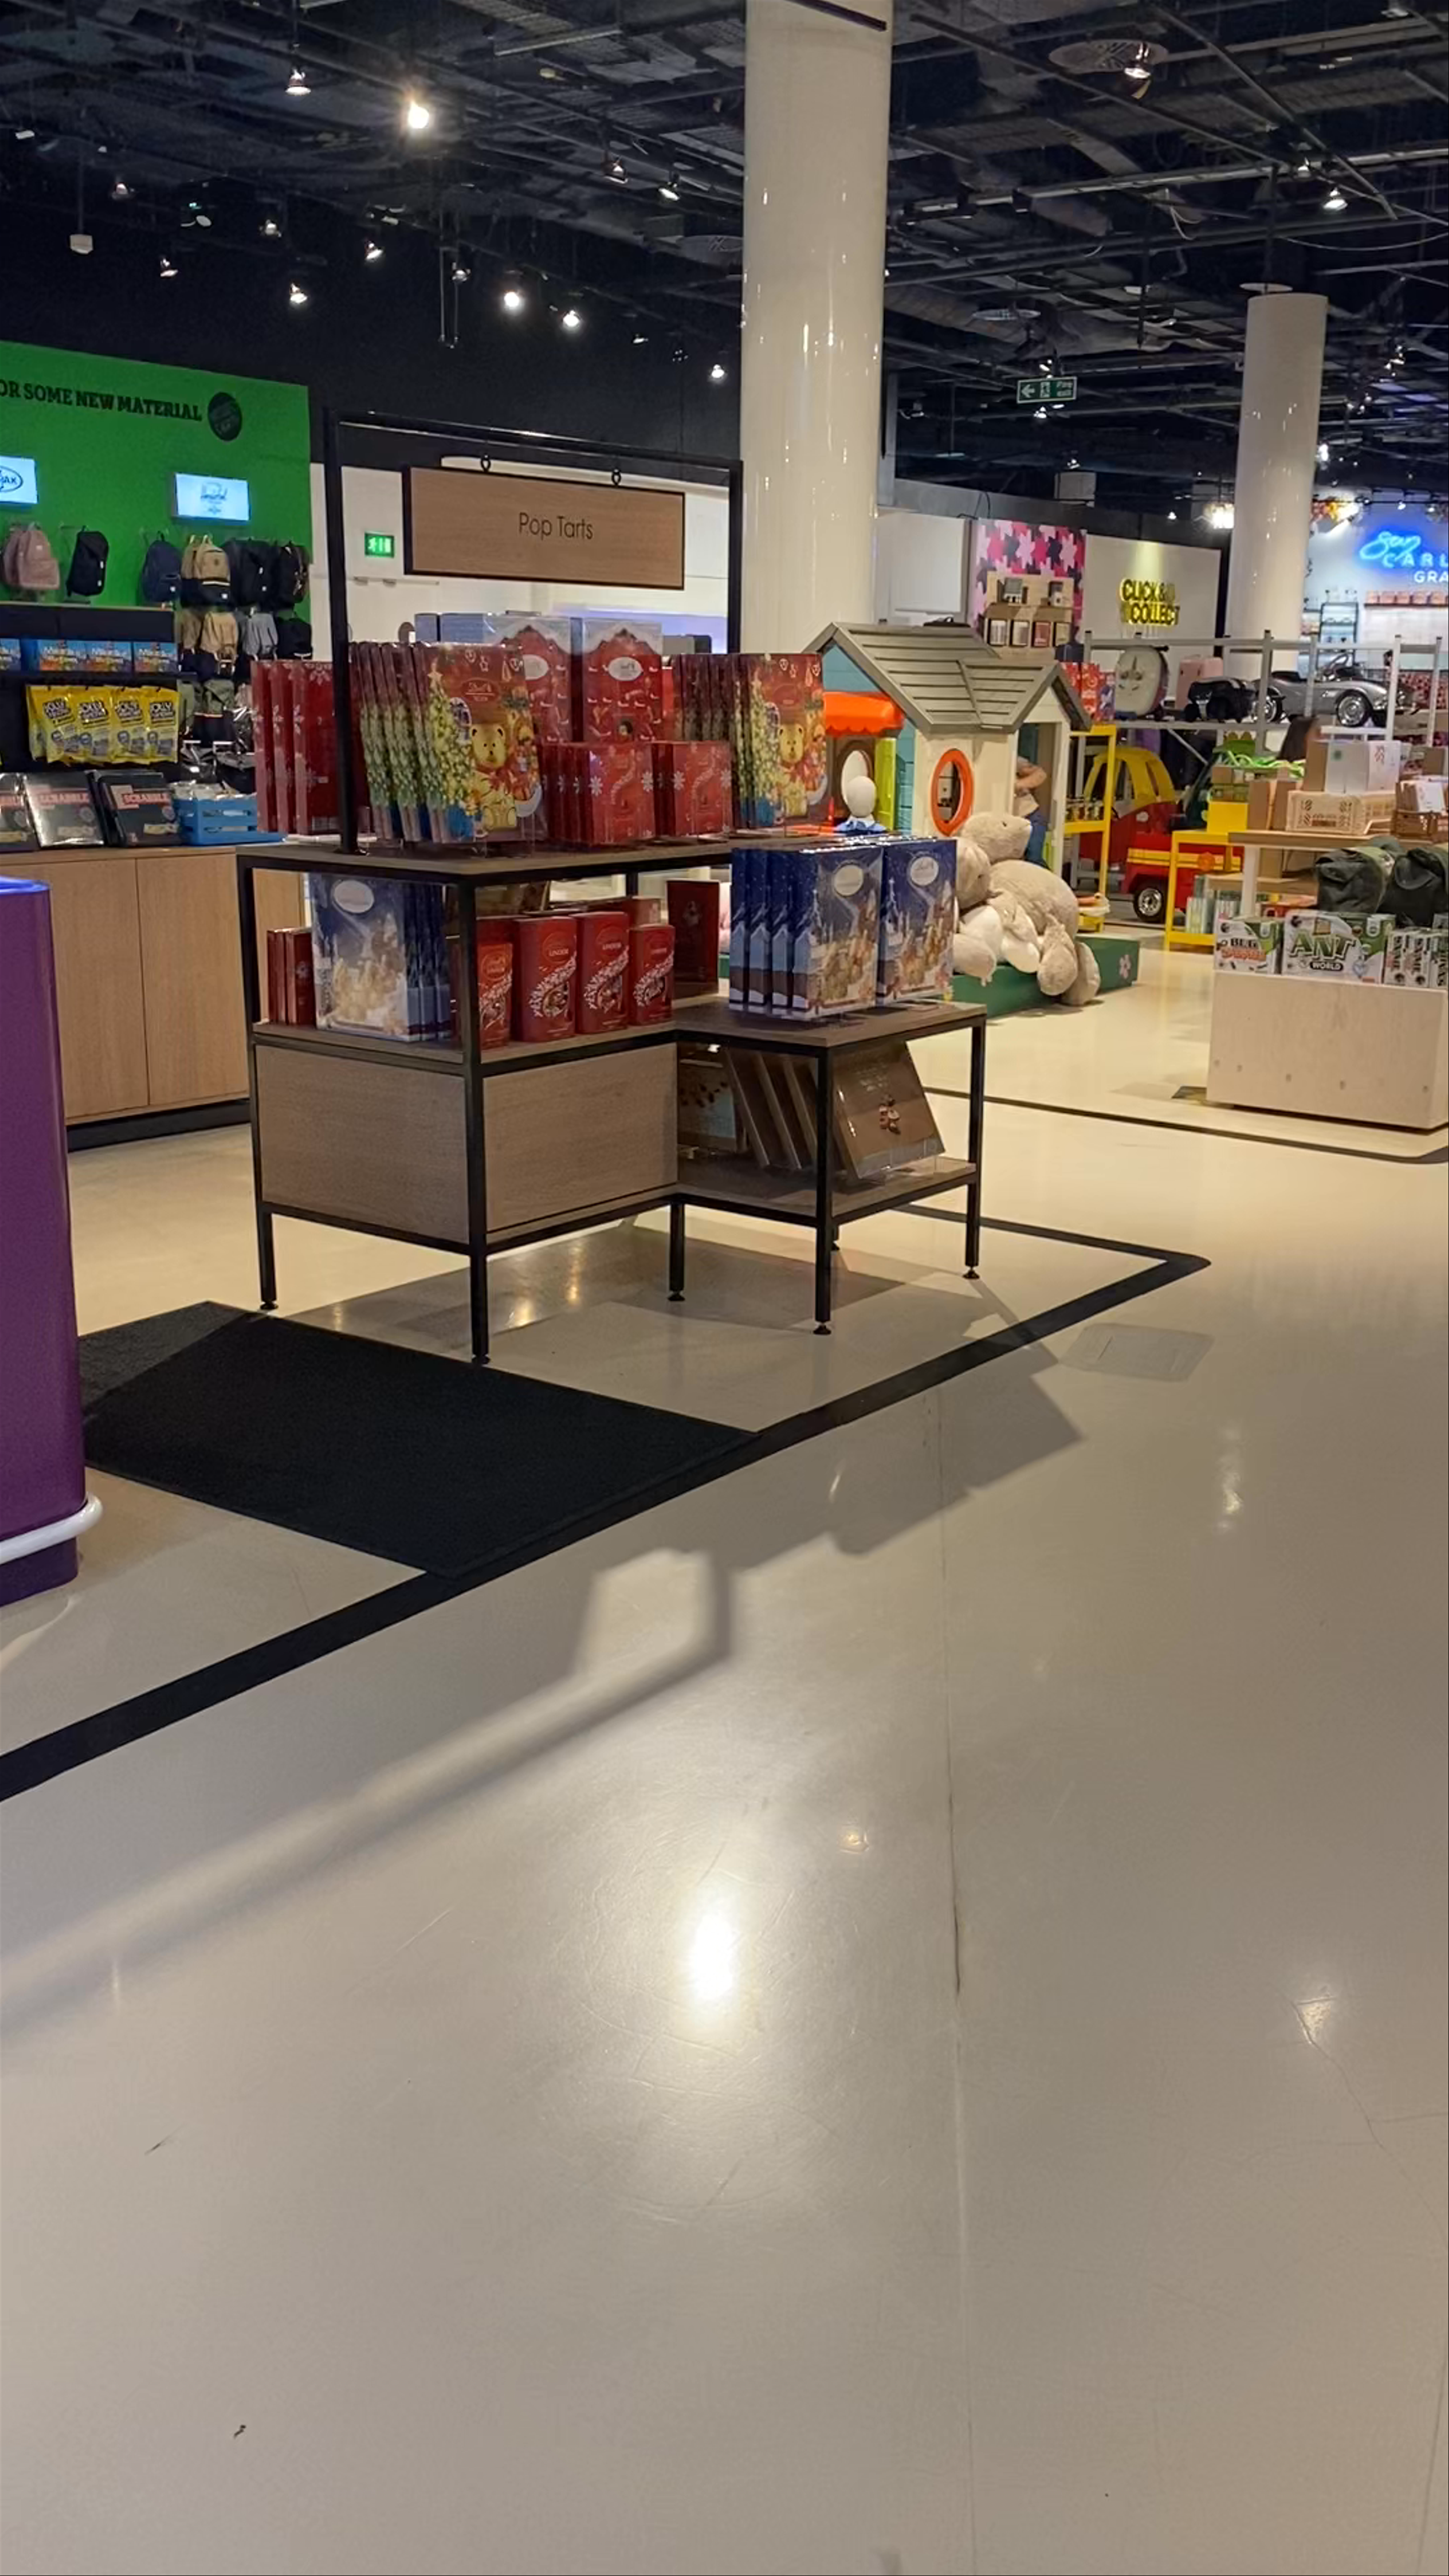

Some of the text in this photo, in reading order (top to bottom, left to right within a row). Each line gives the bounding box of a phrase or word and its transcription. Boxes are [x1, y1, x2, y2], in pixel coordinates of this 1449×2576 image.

[23, 383, 72, 406] SOME
[76, 391, 114, 411] NEW
[117, 395, 202, 421] MATERIAL
[519, 512, 593, 541] Pop Tarts
[1382, 552, 1448, 568] CARL
[1123, 579, 1160, 601] CLICK
[1131, 603, 1180, 625] COLLECT
[1286, 929, 1356, 960] ANT
